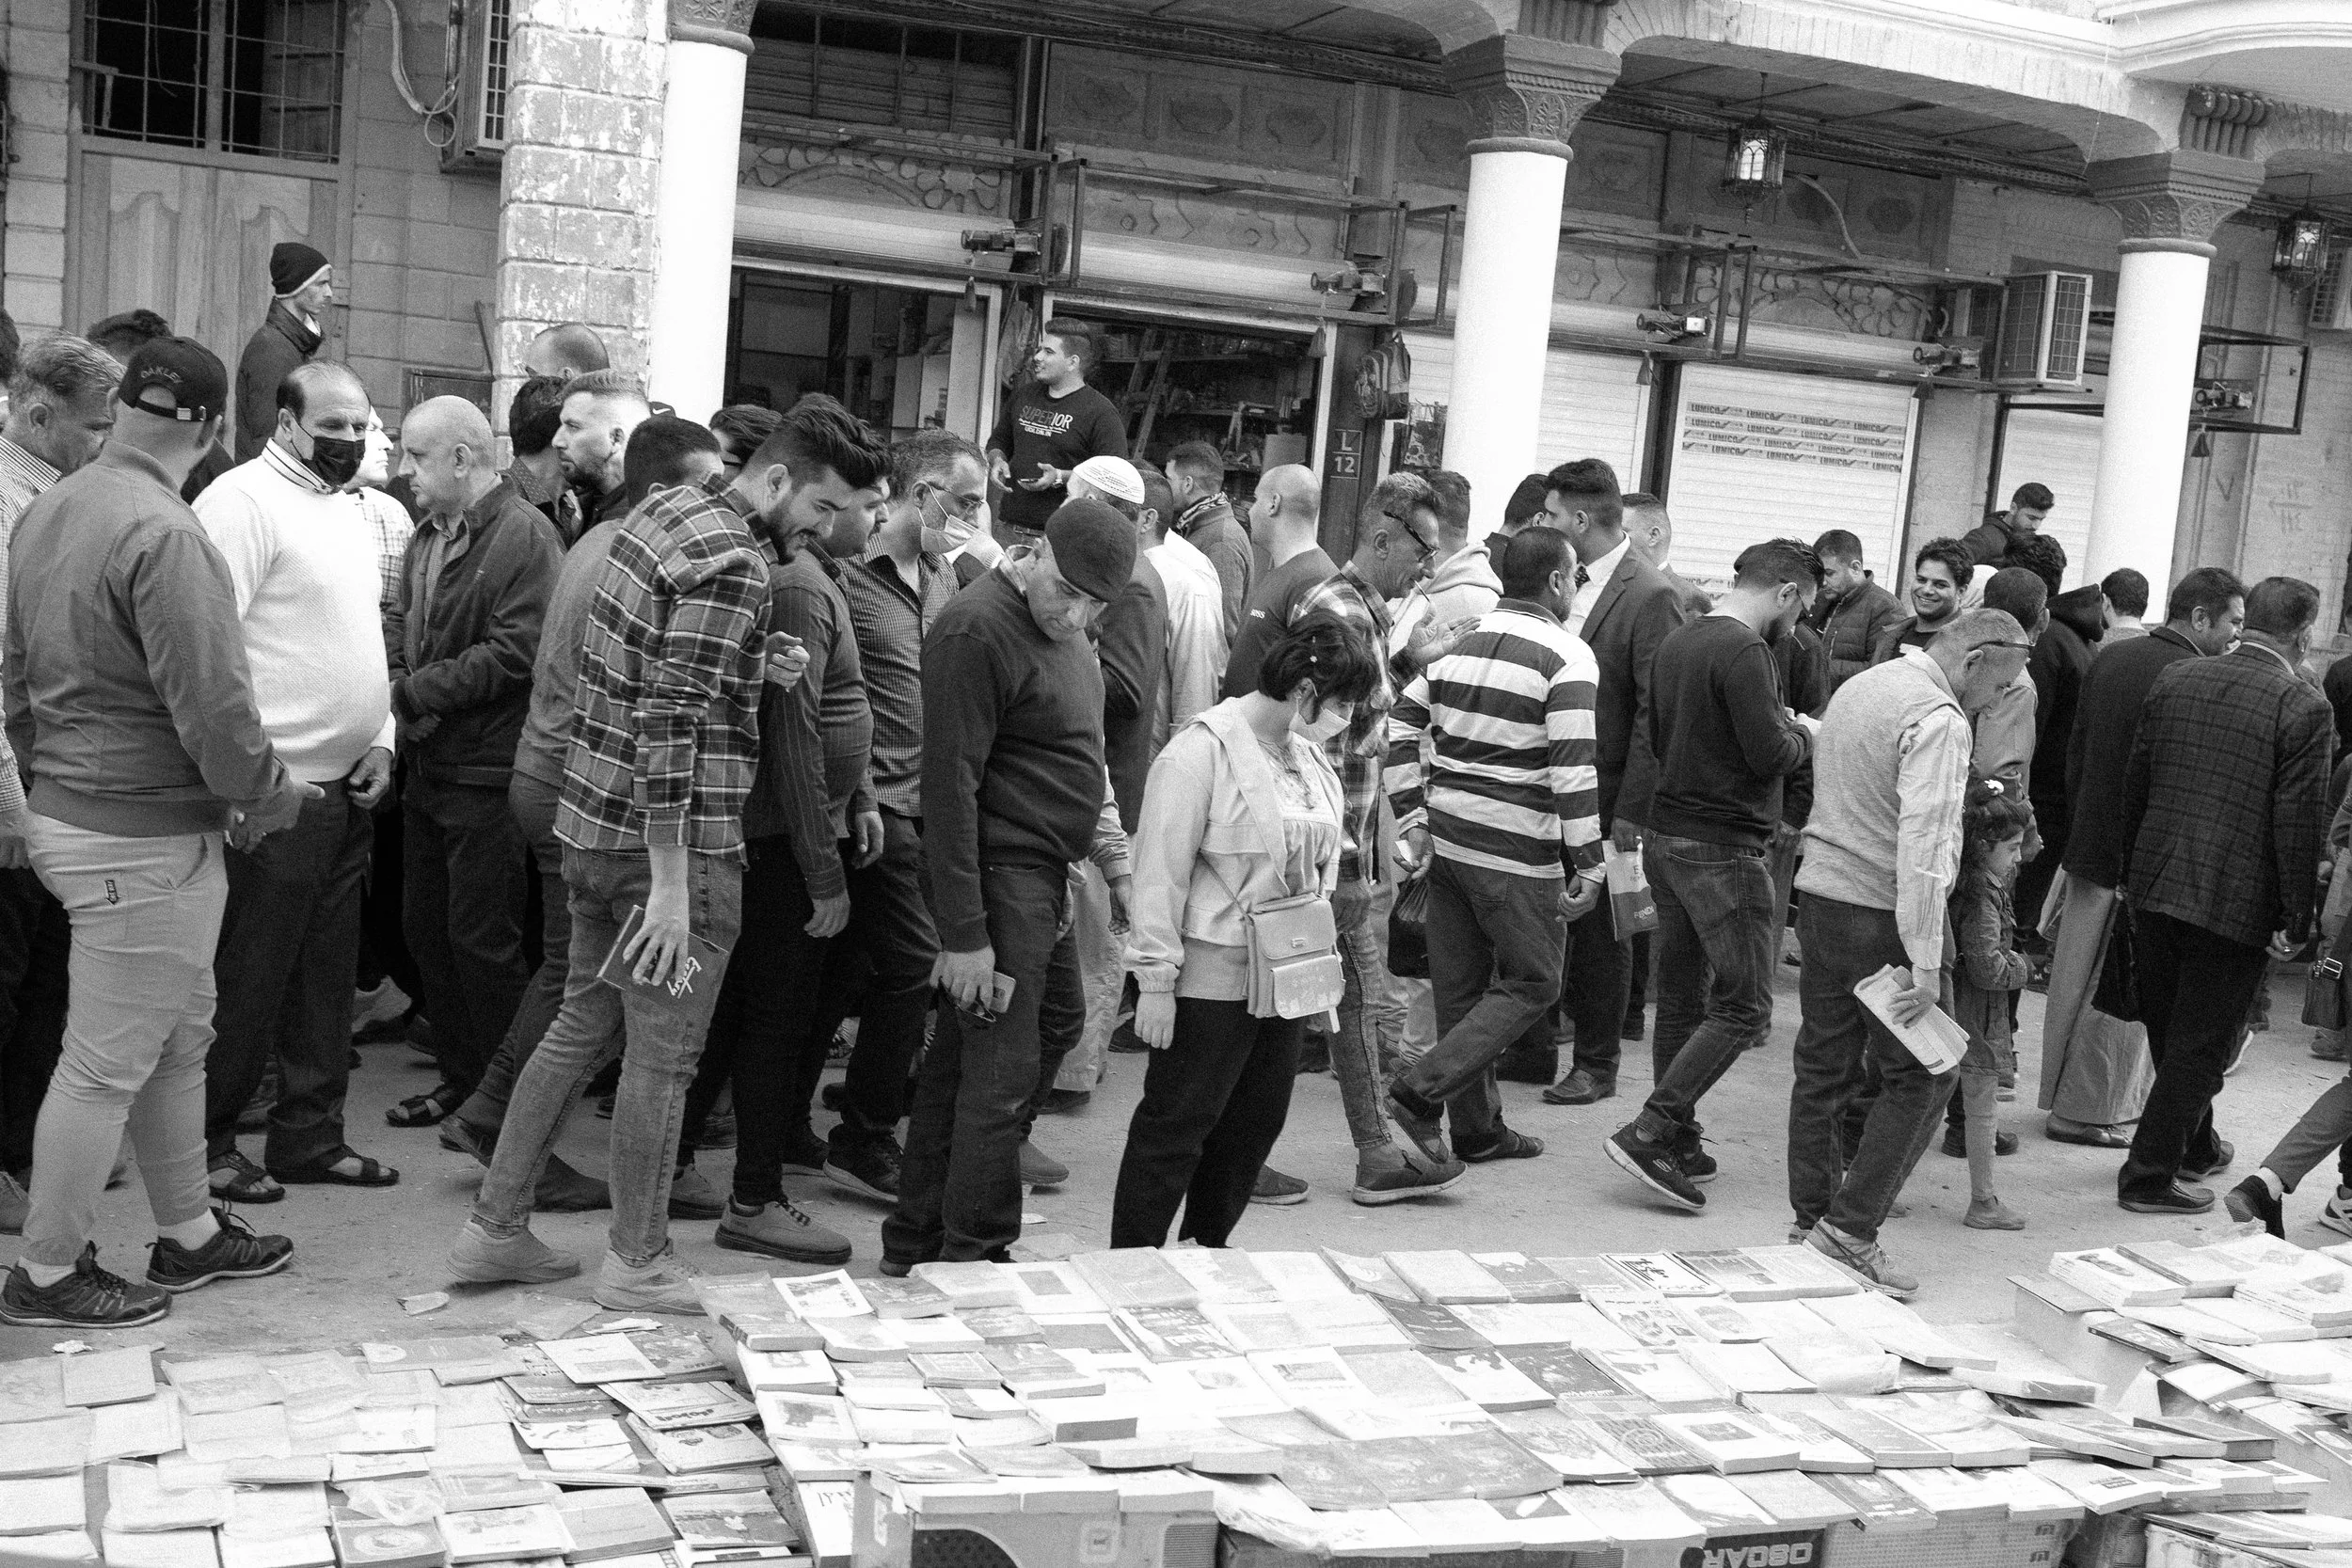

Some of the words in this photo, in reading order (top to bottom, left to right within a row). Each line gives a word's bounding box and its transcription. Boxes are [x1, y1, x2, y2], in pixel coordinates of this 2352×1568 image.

[140, 365, 183, 383] OAKLEY
[1020, 404, 1073, 430] SUPERIOR
[1342, 433, 1353, 451] L
[1335, 456, 1355, 472] 12
